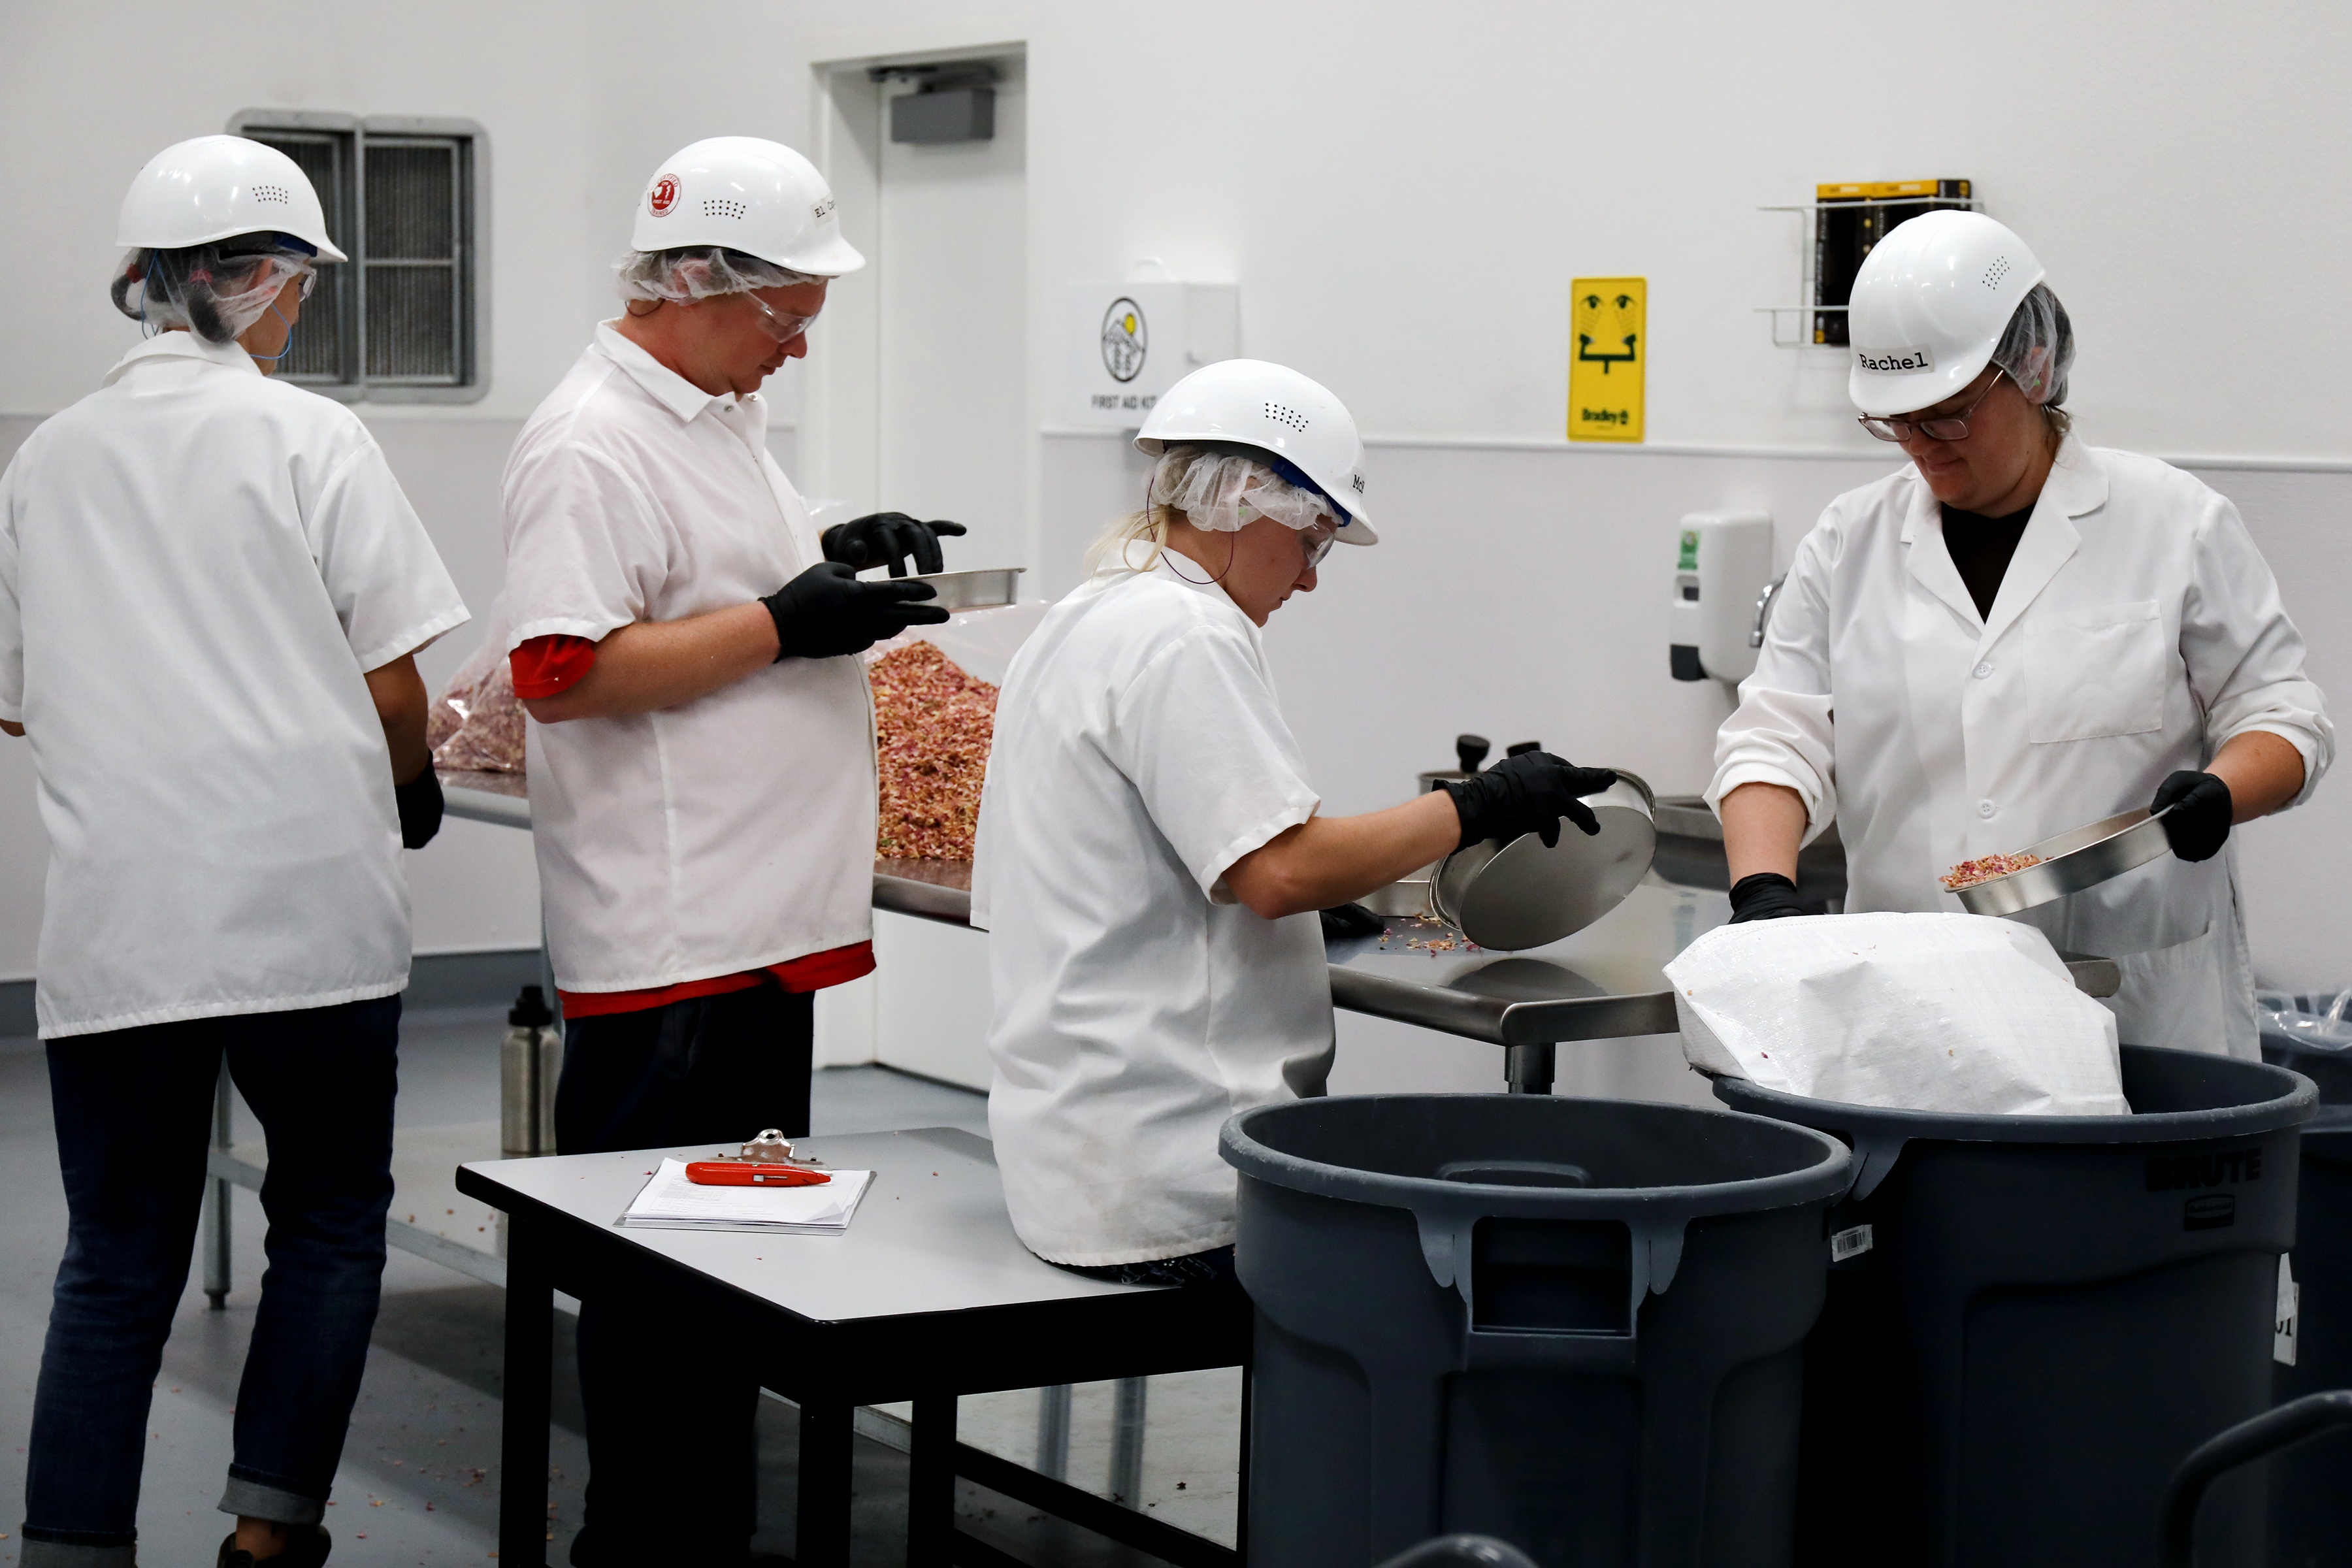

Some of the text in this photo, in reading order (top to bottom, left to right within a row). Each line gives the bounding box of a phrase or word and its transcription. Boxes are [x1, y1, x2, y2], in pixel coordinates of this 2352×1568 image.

[814, 206, 825, 218] El
[1859, 351, 1929, 370] Rachel
[1091, 395, 1119, 409] FIRST
[1122, 395, 1137, 409] AID
[2146, 1147, 2262, 1192] BRUTE
[2190, 1202, 2231, 1213] Rubbermaid
